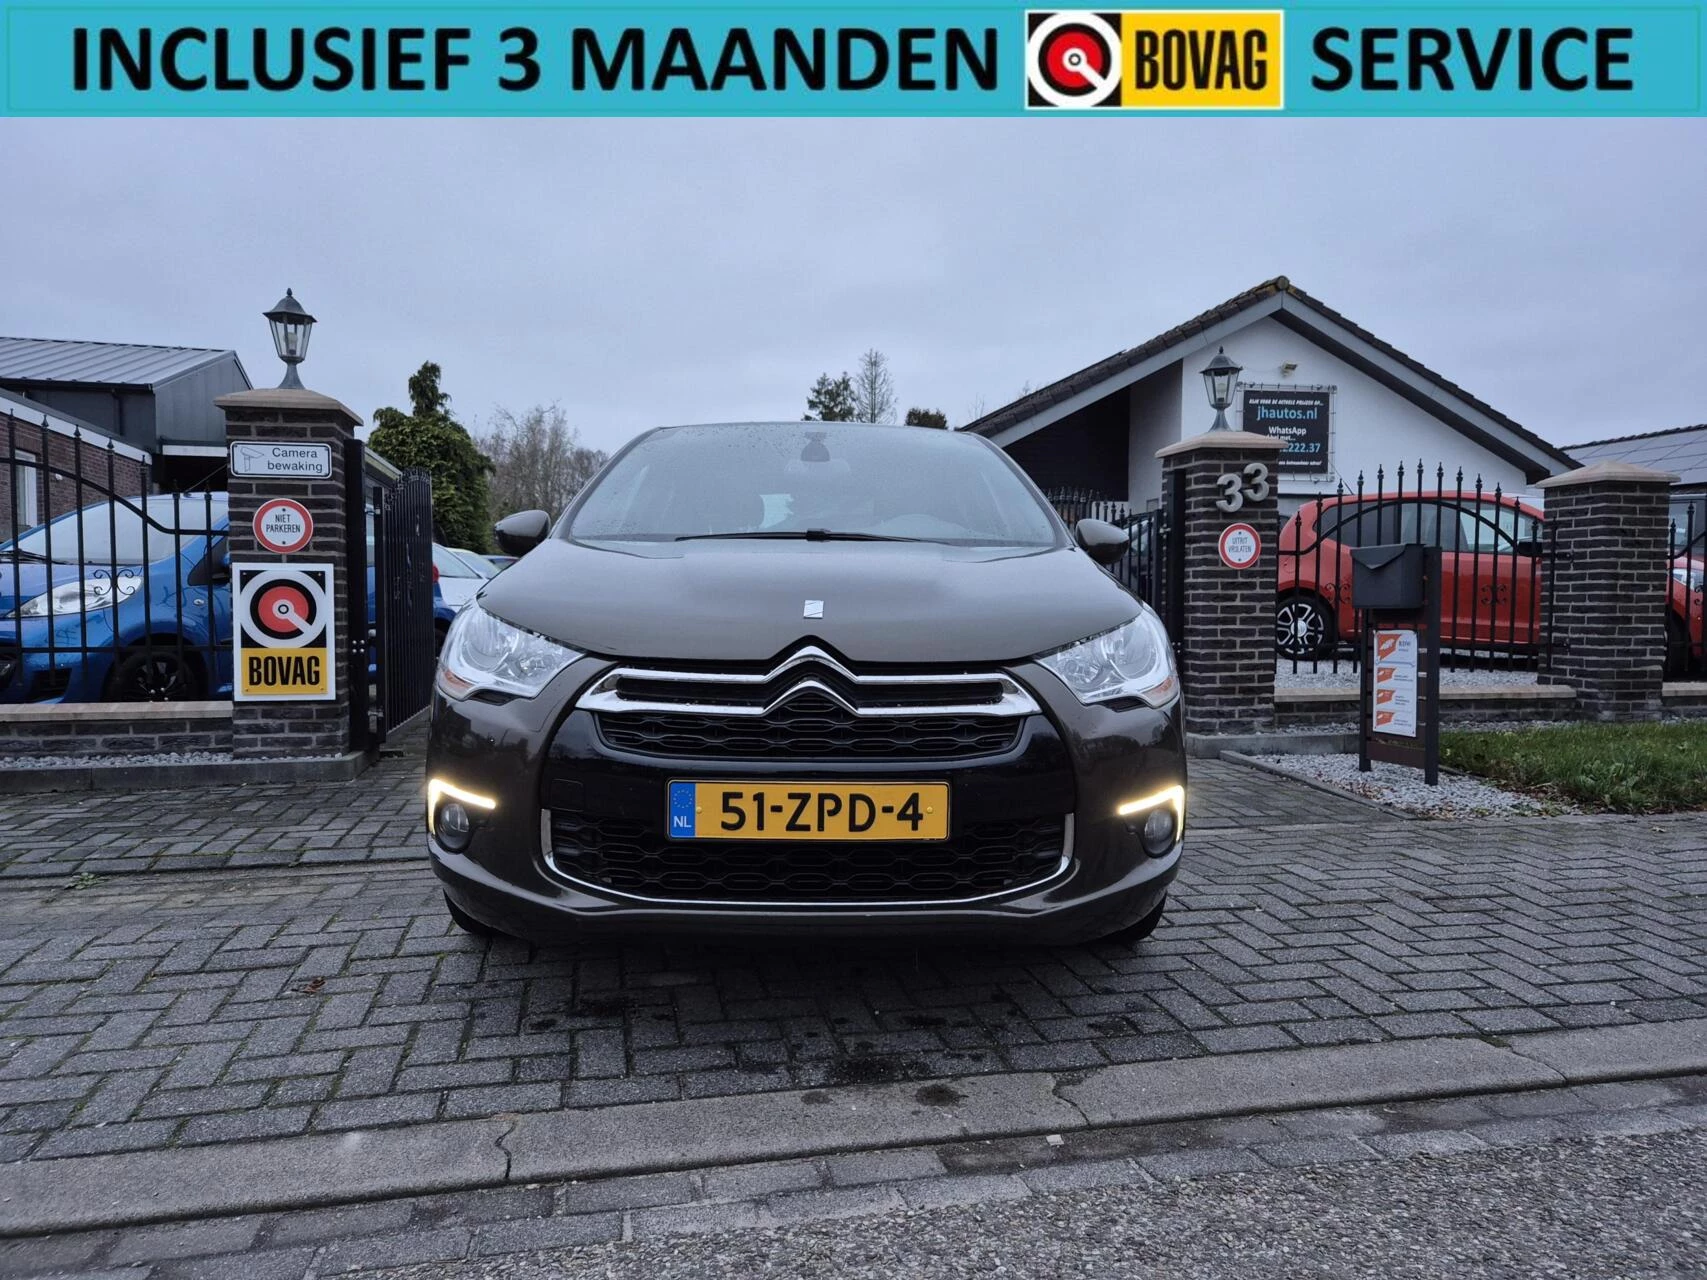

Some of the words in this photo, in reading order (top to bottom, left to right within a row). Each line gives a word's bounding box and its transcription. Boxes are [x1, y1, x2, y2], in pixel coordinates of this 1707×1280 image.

[1256, 406, 1318, 421] jhautos.nl
[1268, 426, 1307, 436] WhatsApp
[272, 447, 318, 458] Camera
[267, 460, 323, 473] bewaking
[1216, 462, 1269, 513] 33
[275, 514, 291, 522] NIET
[266, 524, 301, 533] PARKEREN
[248, 655, 320, 687] BOVAG
[720, 791, 924, 833] 51-ZPD-4
[673, 816, 692, 828] NL
